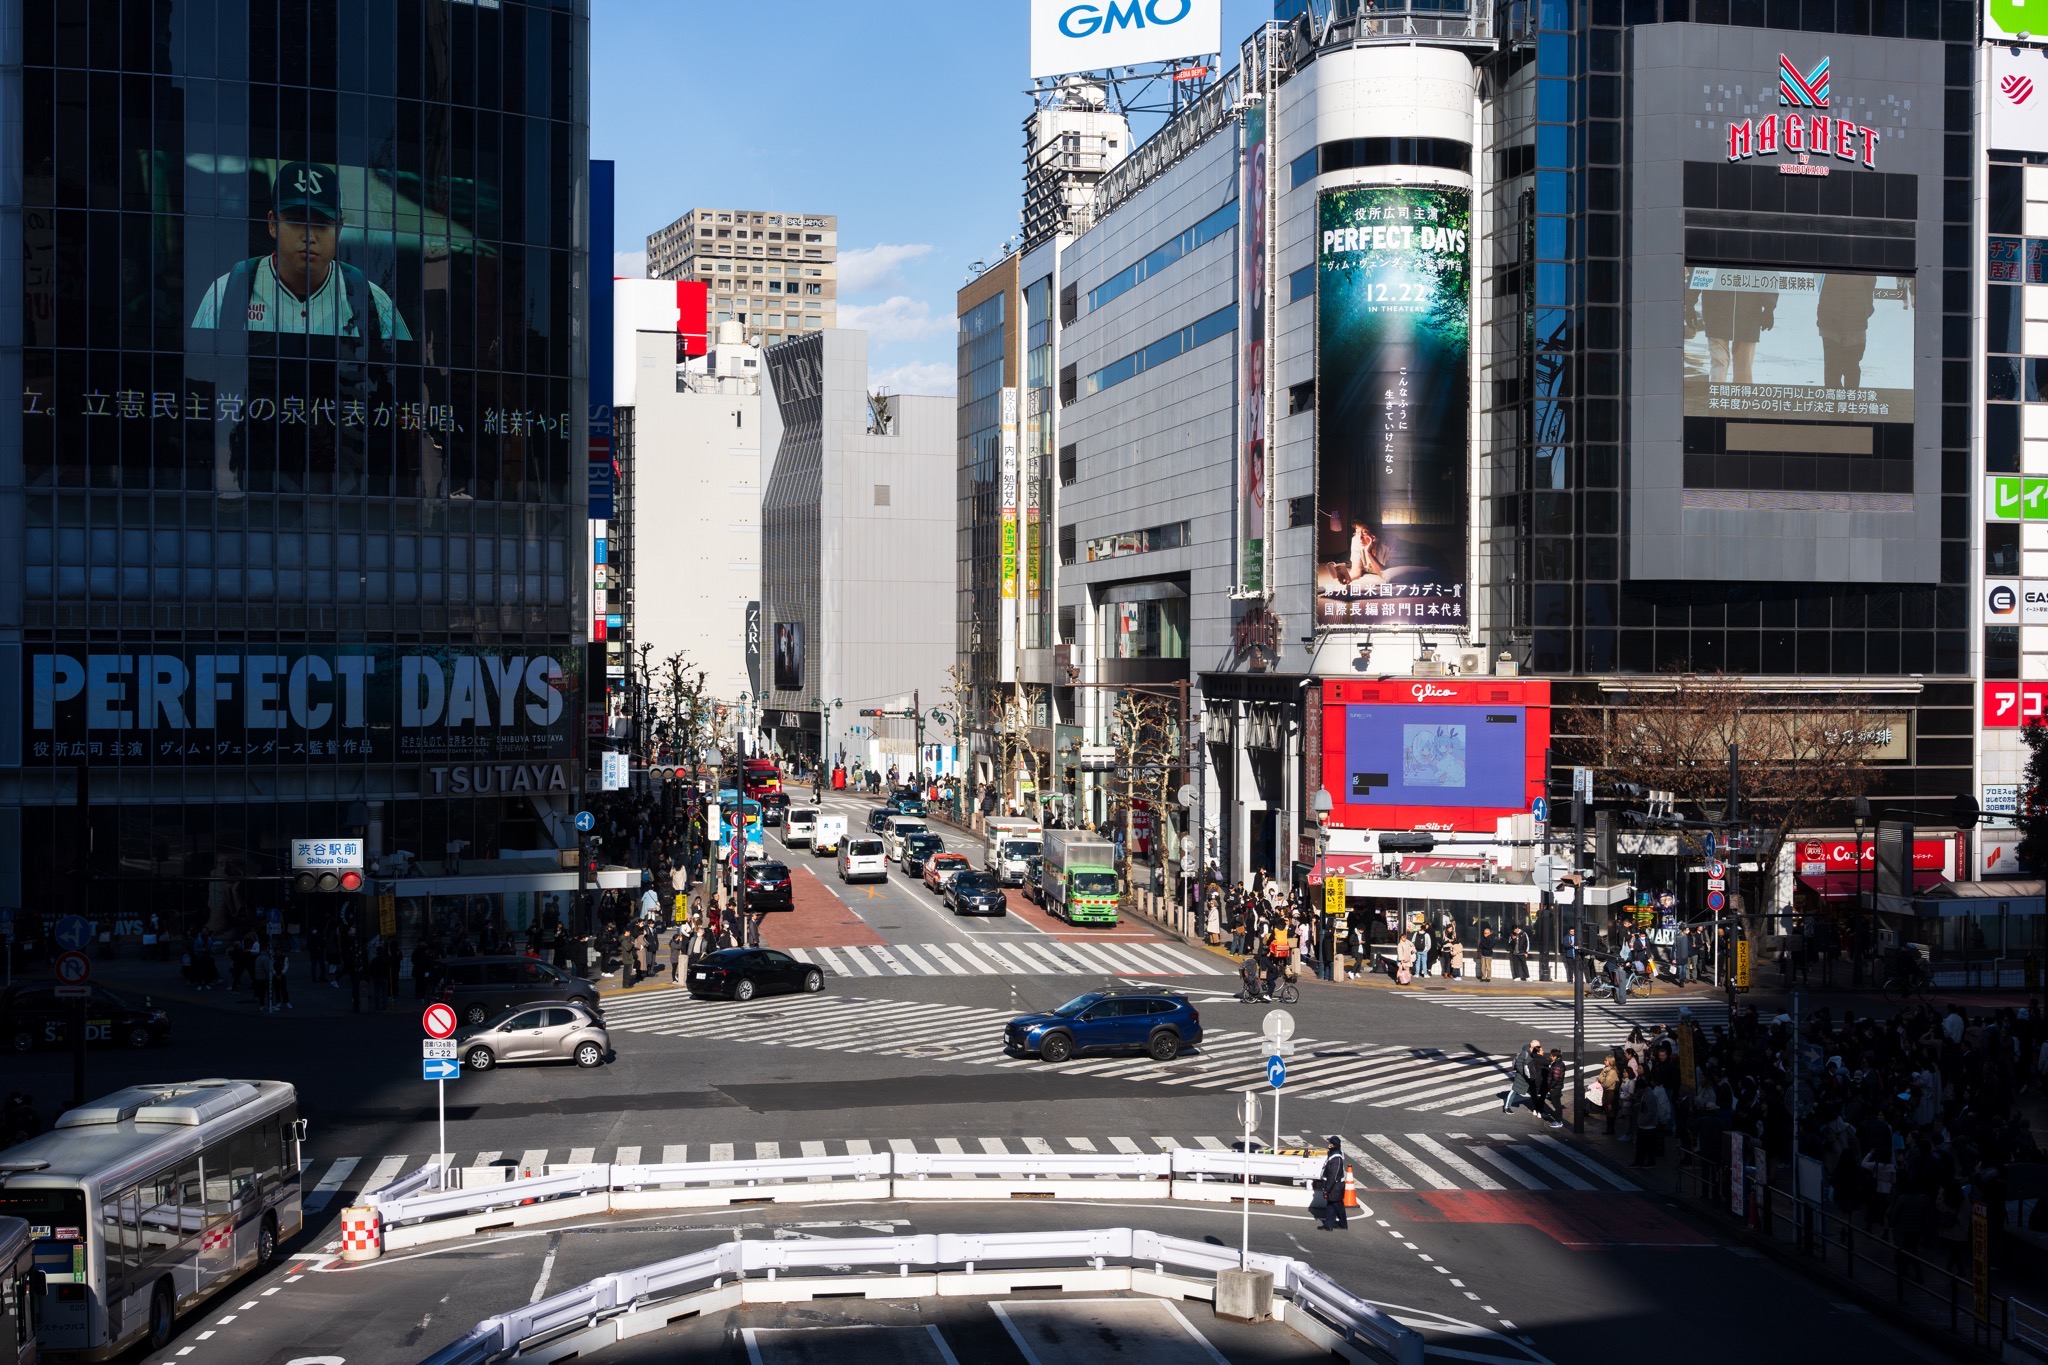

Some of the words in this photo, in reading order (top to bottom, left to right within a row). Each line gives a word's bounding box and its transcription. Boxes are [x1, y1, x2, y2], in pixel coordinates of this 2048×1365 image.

[1058, 0, 1192, 38] GMO
[1727, 113, 1879, 169] MAGNET
[1799, 153, 1809, 164] by
[1780, 163, 1830, 176] SHIBUYA109
[1354, 207, 1410, 221] 役所広司
[1323, 226, 1416, 254] PERFECT
[1421, 226, 1466, 254] DAYS
[1989, 260, 2042, 281] 居酒屋
[1720, 274, 1816, 292] 65歳以上の介護保険料
[1367, 283, 1426, 302] 12.22
[1875, 290, 1904, 299] イメージ
[1381, 305, 1425, 313] THEATERS
[1398, 366, 1409, 430] こんなふうに
[1708, 385, 1878, 402] 年間所得420万円以上の高齢者対象
[1003, 390, 1016, 423] 皮ふ科
[1708, 398, 1836, 414] 来年度からの引き上げ決定
[1837, 401, 1890, 415] 厚生労働省
[1384, 389, 1395, 475] 生きていけたなら
[1004, 445, 1015, 469] 内科
[1003, 474, 1016, 507] 処方せん
[2025, 592, 2048, 603] EA
[1324, 602, 1462, 617] 国際長編部門日本代表
[748, 610, 760, 654] ZARA
[33, 654, 375, 729] PERFECT
[401, 655, 564, 728] DAYS
[1411, 683, 1458, 702] Glico
[1995, 692, 2048, 716] アコ
[588, 715, 604, 733] 本
[33, 740, 104, 757] 役所広司
[496, 735, 530, 744] SHIBUYA
[428, 763, 567, 795] TSUTAYA
[298, 843, 358, 857] 渋谷駅前
[306, 857, 334, 866] Shibuya
[336, 857, 351, 865] Sta.
[69, 1303, 86, 1312] 820
